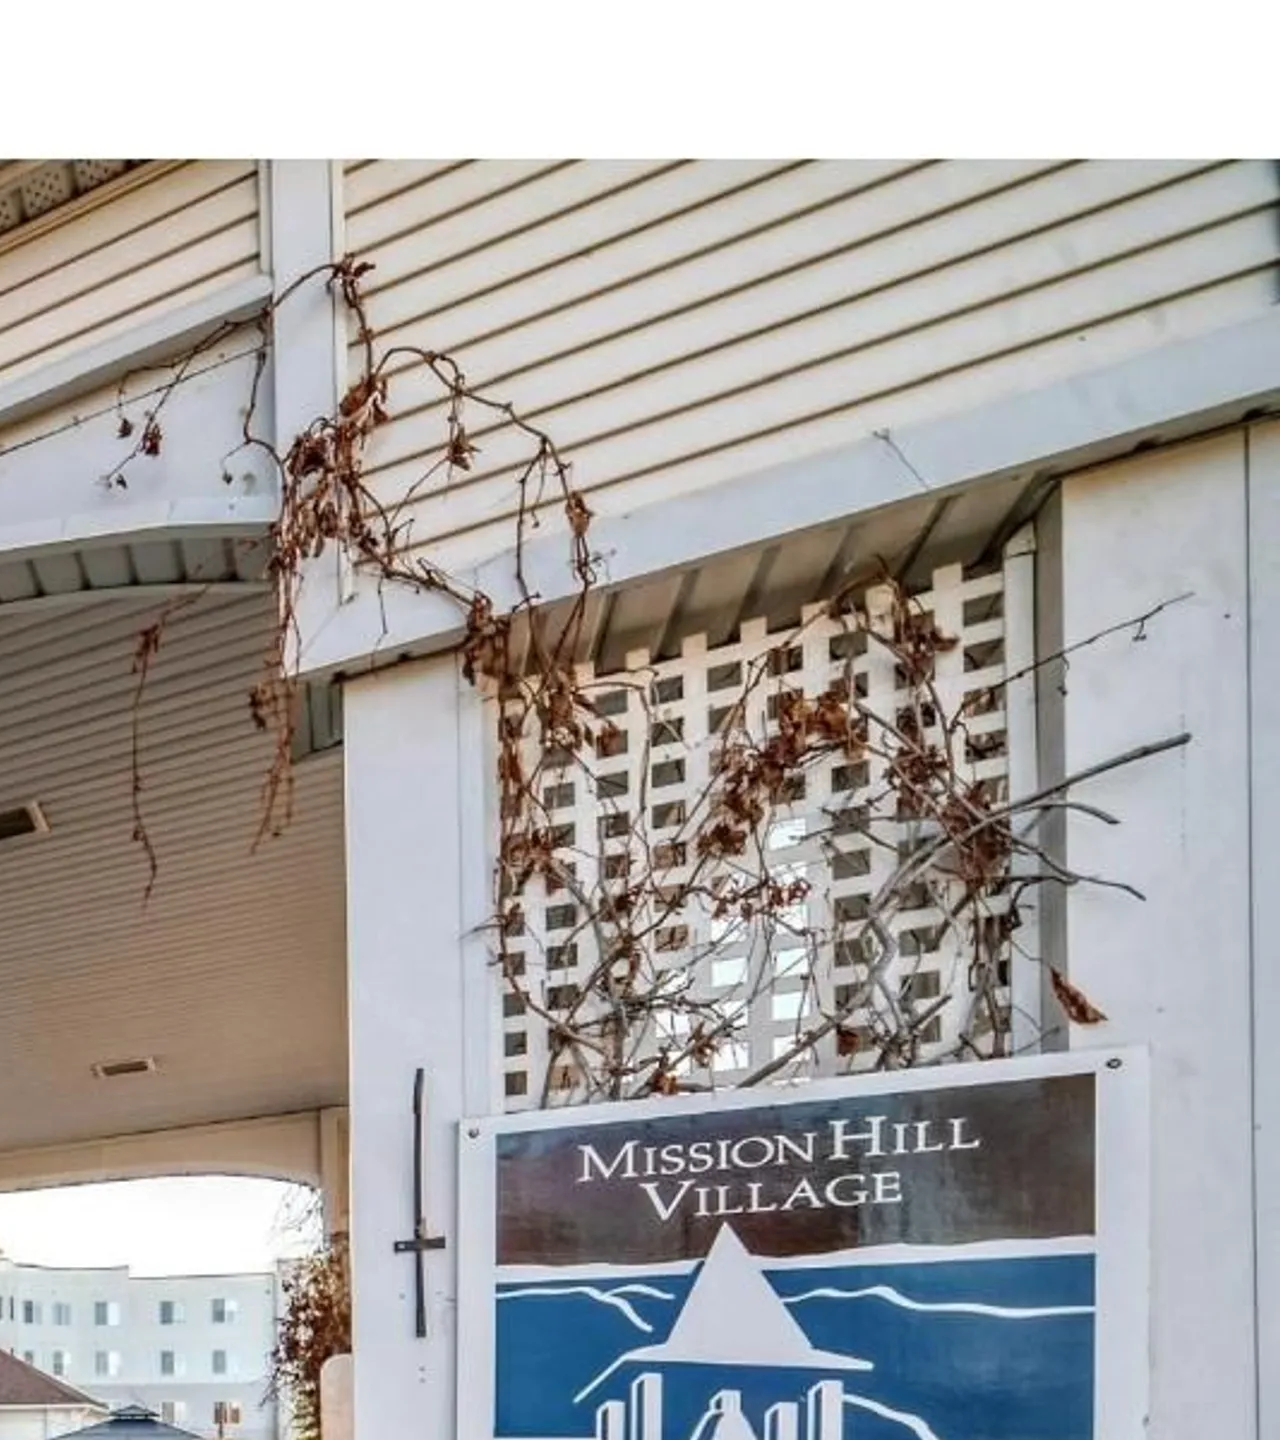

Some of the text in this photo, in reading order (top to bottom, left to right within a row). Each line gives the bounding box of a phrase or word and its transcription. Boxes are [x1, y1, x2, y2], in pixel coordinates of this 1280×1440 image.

[577, 1114, 981, 1184] MISSION HILL
[638, 1171, 903, 1223] VILLAGE
